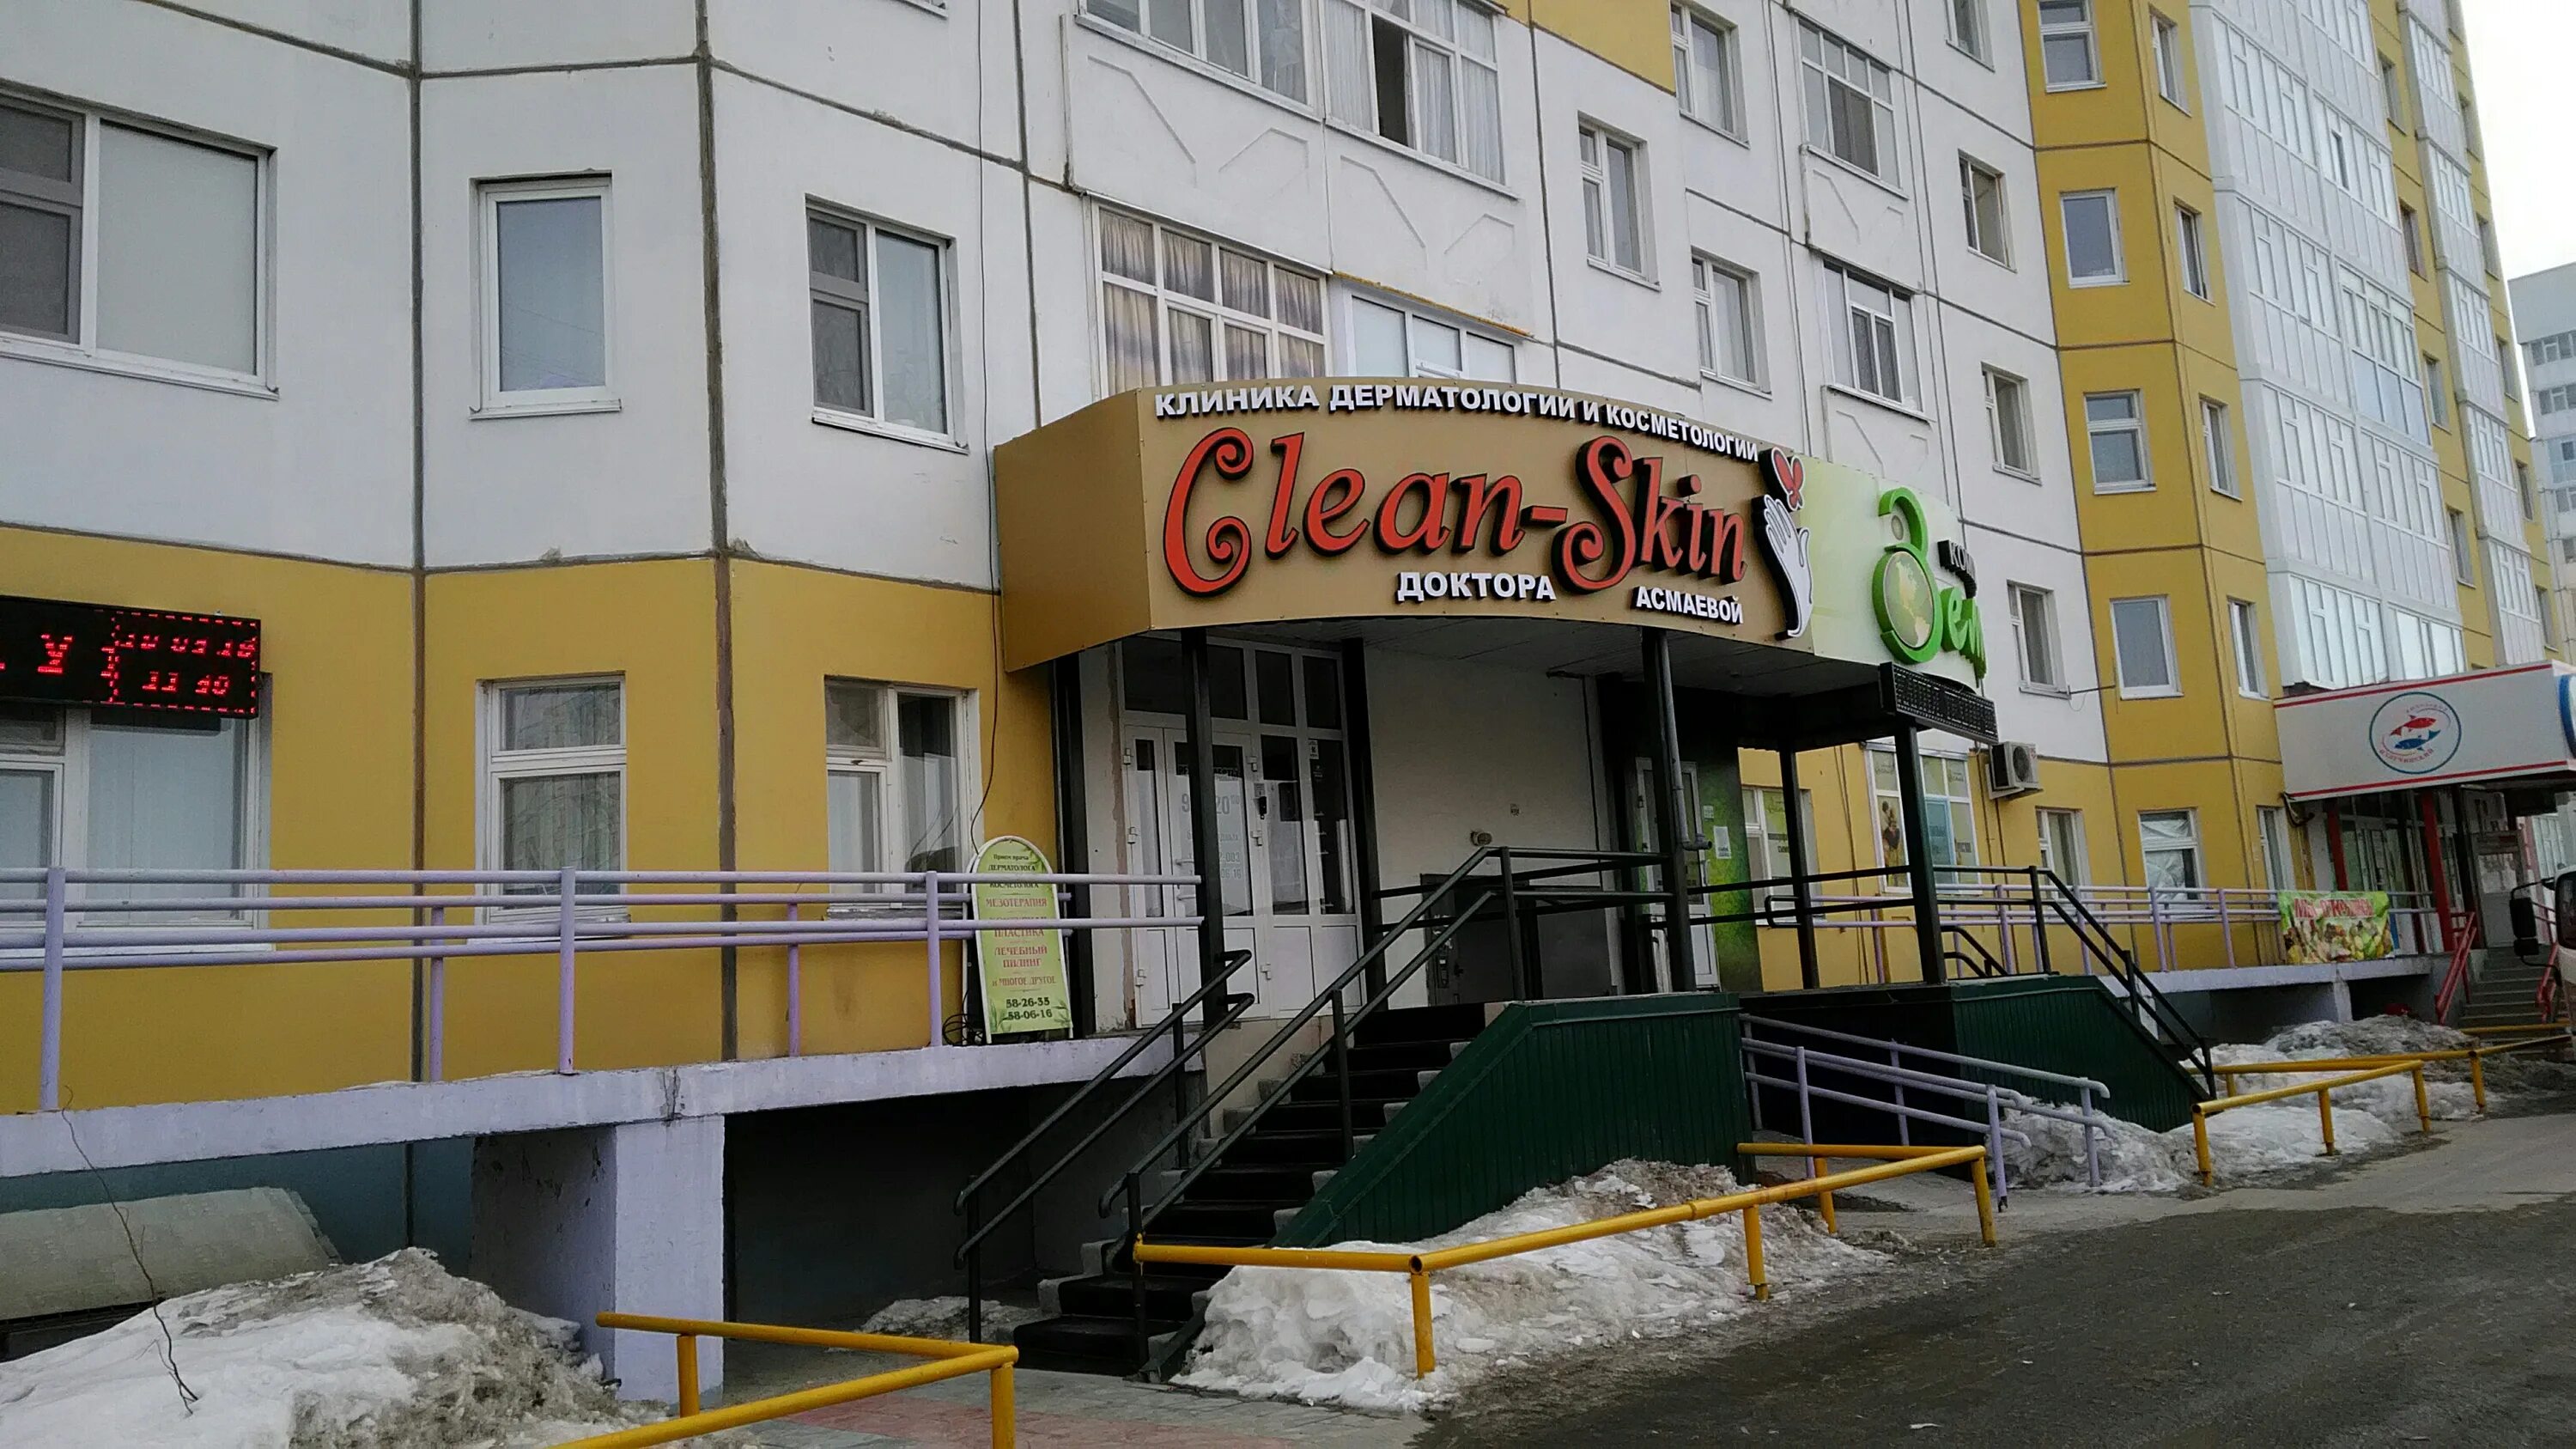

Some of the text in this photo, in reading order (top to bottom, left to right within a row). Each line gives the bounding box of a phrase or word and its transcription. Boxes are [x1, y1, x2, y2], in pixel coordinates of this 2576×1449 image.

[1155, 384, 1759, 463] КЛИНИКА ДЕРМАТОЛОГИИ И КОСМЕТОЛОГИИ
[1163, 426, 1748, 596] Clean-Skin
[1397, 571, 1557, 602] ДОКТОРА
[1635, 586, 1744, 624] АСМАЕВОЙ
[995, 945, 1048, 955] ЛЕЧЕБНЫЙ
[1003, 959, 1041, 968] ПИЛИНГ
